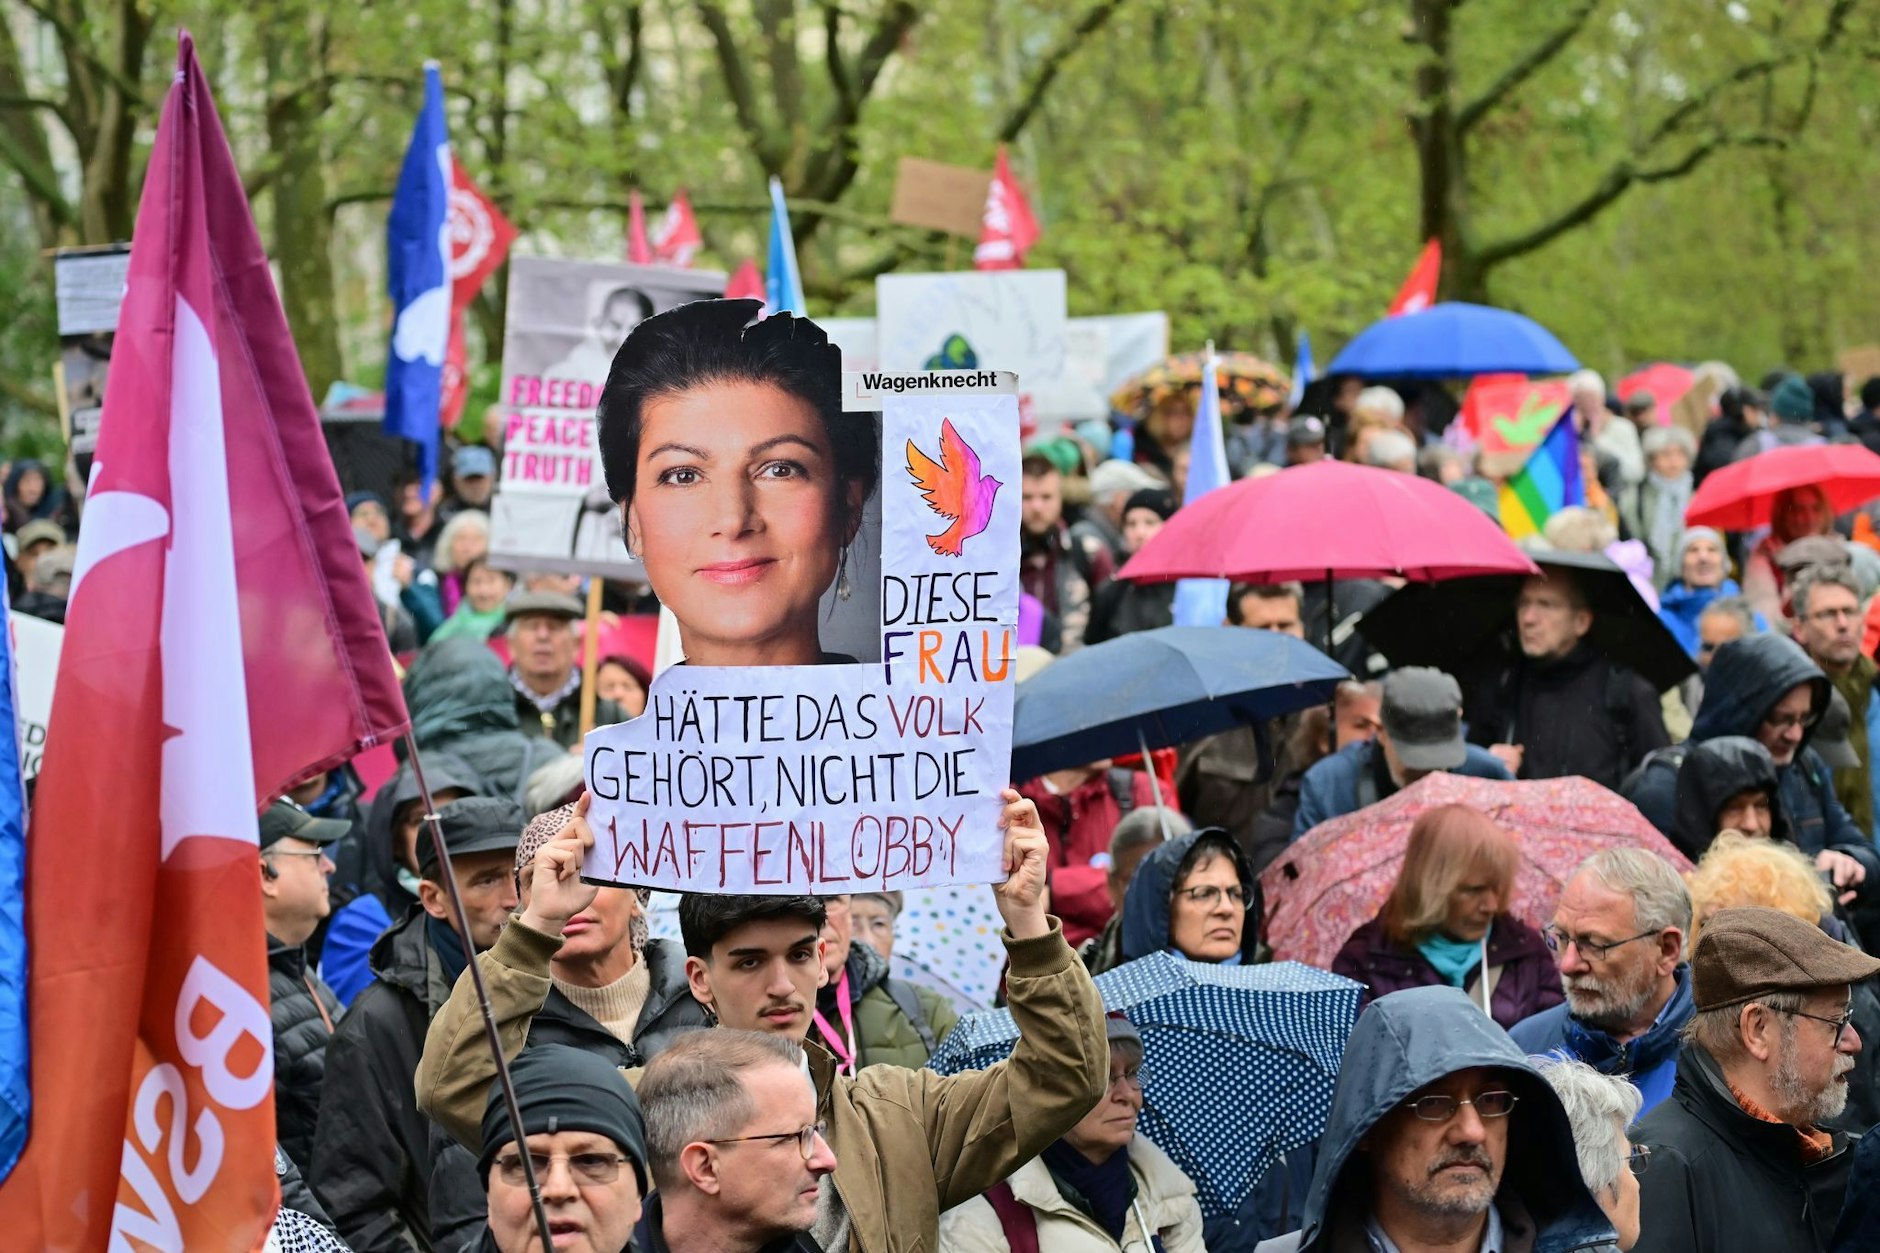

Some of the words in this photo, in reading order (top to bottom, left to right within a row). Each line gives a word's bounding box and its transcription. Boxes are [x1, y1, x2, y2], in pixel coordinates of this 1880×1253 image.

[863, 371, 997, 393] Wagenknecht
[506, 413, 592, 448] PEACE
[507, 452, 592, 485] TRUTH
[883, 572, 998, 626] DIESE
[884, 630, 1010, 685] FRAU
[655, 690, 785, 742] HÄTTE
[797, 694, 877, 740] DAS
[887, 695, 985, 738] VOLK
[591, 747, 767, 812] GEHÖRT,
[776, 753, 905, 806] NICHT
[914, 749, 979, 799] DIE
[609, 814, 965, 891] WAFFENLOBBY
